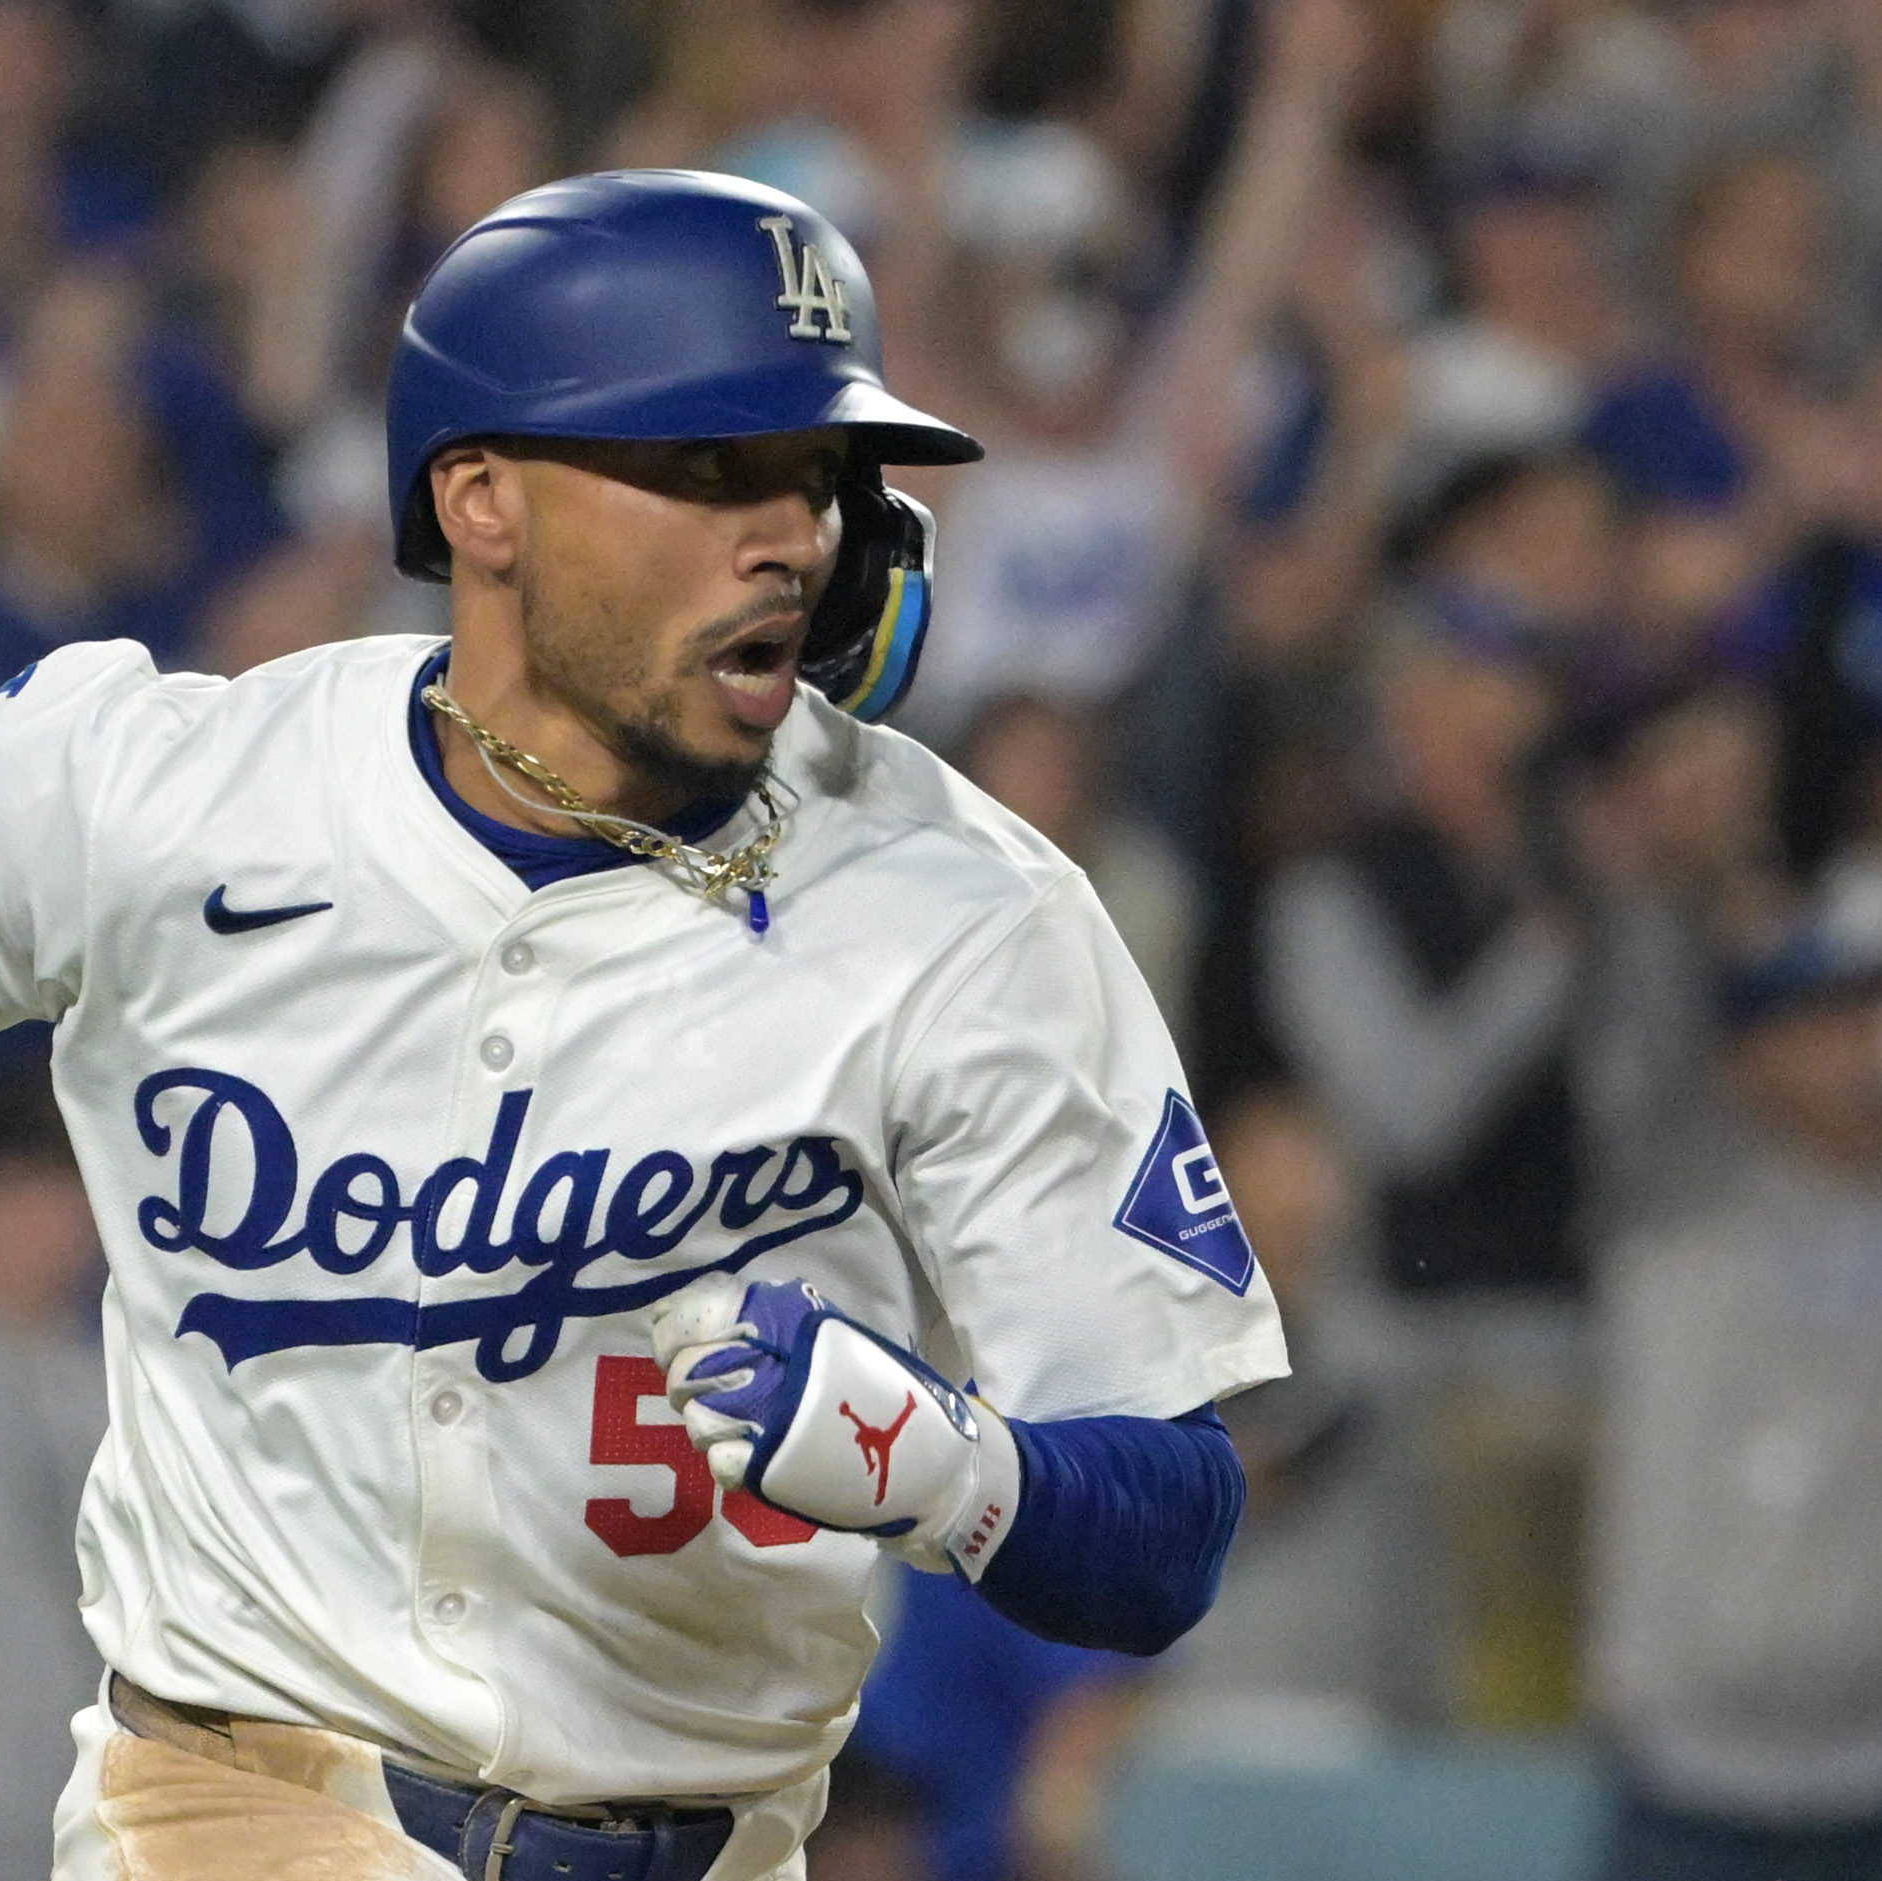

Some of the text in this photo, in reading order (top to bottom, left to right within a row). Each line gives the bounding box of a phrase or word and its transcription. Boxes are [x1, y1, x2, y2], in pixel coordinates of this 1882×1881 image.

[758, 214, 851, 341] LA
[133, 1066, 865, 1384] Dodgers
[1178, 1211, 1239, 1242] GUGGEN
[584, 1354, 819, 1558] 5
[962, 1503, 1001, 1564] MB
